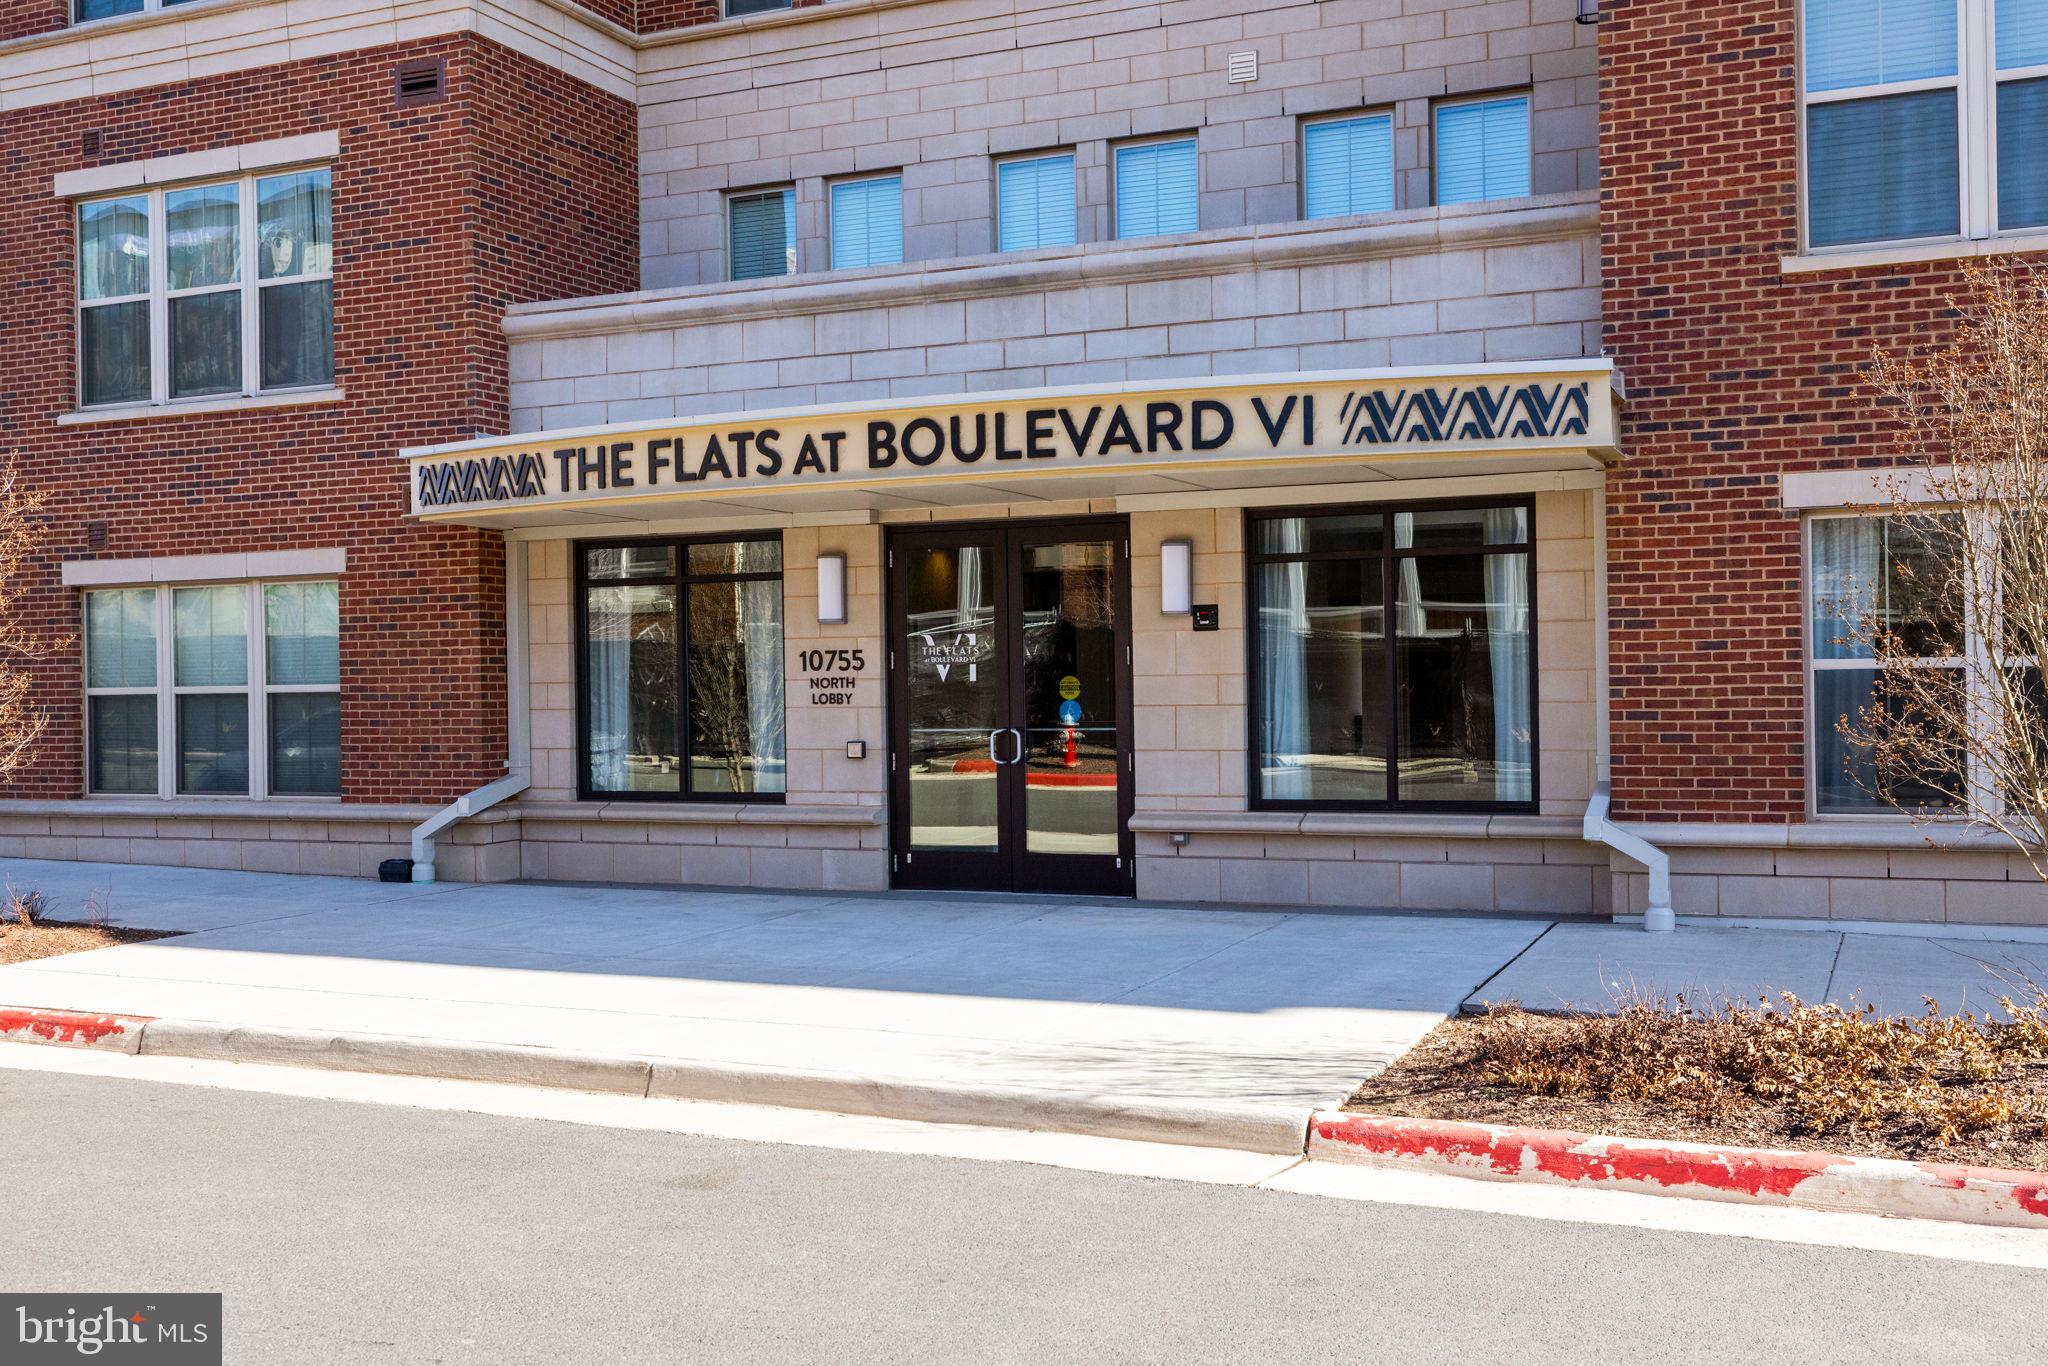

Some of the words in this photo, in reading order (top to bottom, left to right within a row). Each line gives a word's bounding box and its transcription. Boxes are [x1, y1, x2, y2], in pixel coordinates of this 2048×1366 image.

[554, 442, 635, 493] THE
[647, 429, 783, 485] FLATS
[793, 431, 847, 475] AT
[868, 402, 1234, 469] BOULEVARD
[1251, 395, 1315, 447] VI
[922, 646, 941, 655] THE
[944, 645, 979, 655] FLATS
[800, 649, 865, 672] 10755
[810, 677, 856, 689] NORTH
[812, 693, 853, 705] LOBBY
